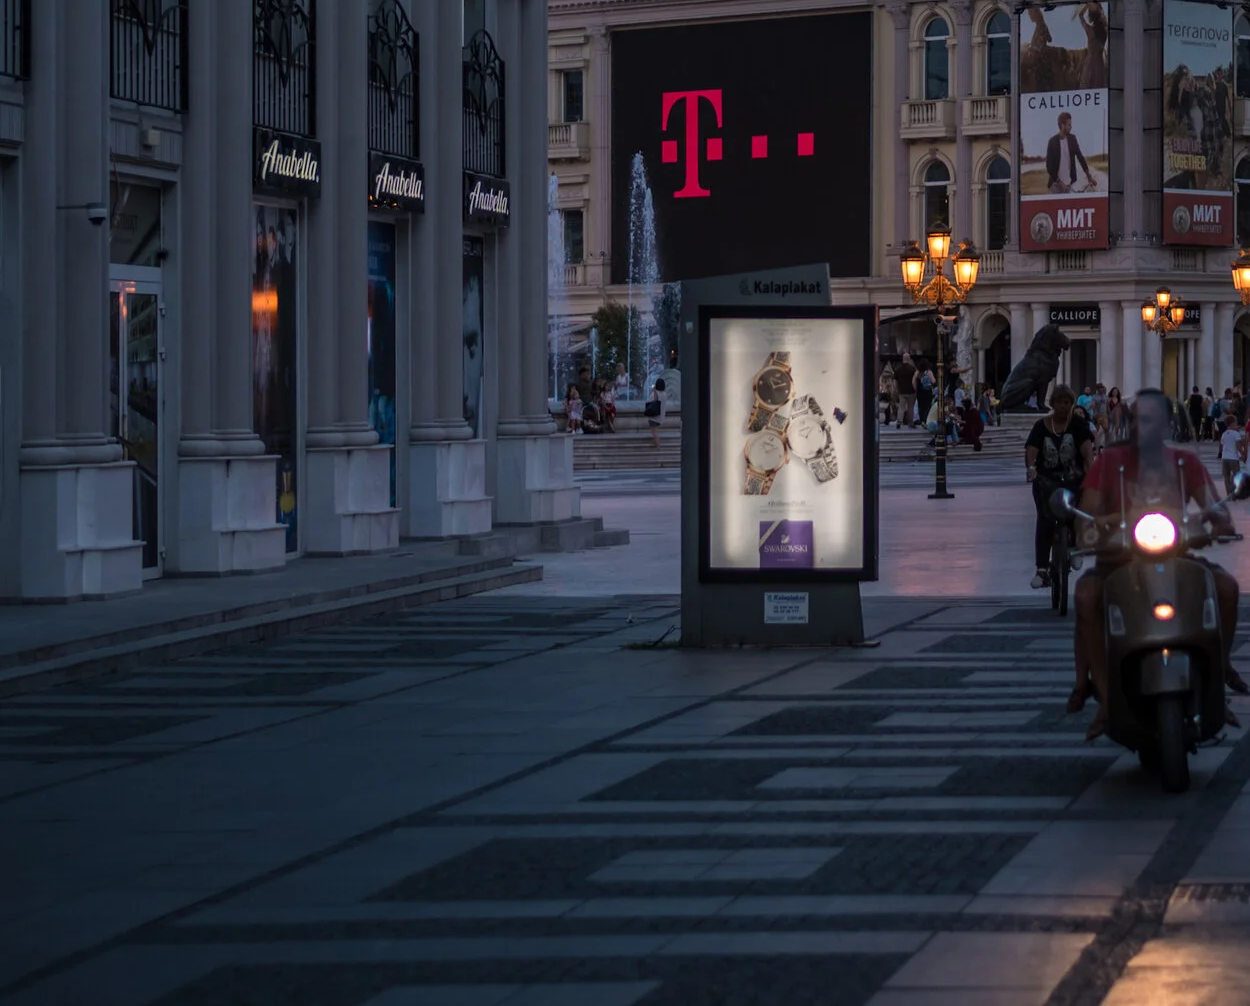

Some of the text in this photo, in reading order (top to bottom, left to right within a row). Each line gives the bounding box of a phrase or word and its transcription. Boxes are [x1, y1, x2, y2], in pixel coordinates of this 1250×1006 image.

[1028, 92, 1101, 110] CALLIOPE
[1170, 153, 1207, 171] TOGETHER
[1057, 208, 1096, 229] МИТ
[1193, 204, 1222, 223] МИТ
[1056, 229, 1097, 241] УНИВЕРЗИТЕТ
[753, 280, 822, 298] Kalaplakat
[1050, 310, 1097, 320] CALLIOPE
[764, 545, 808, 553] SWAROVSKI
